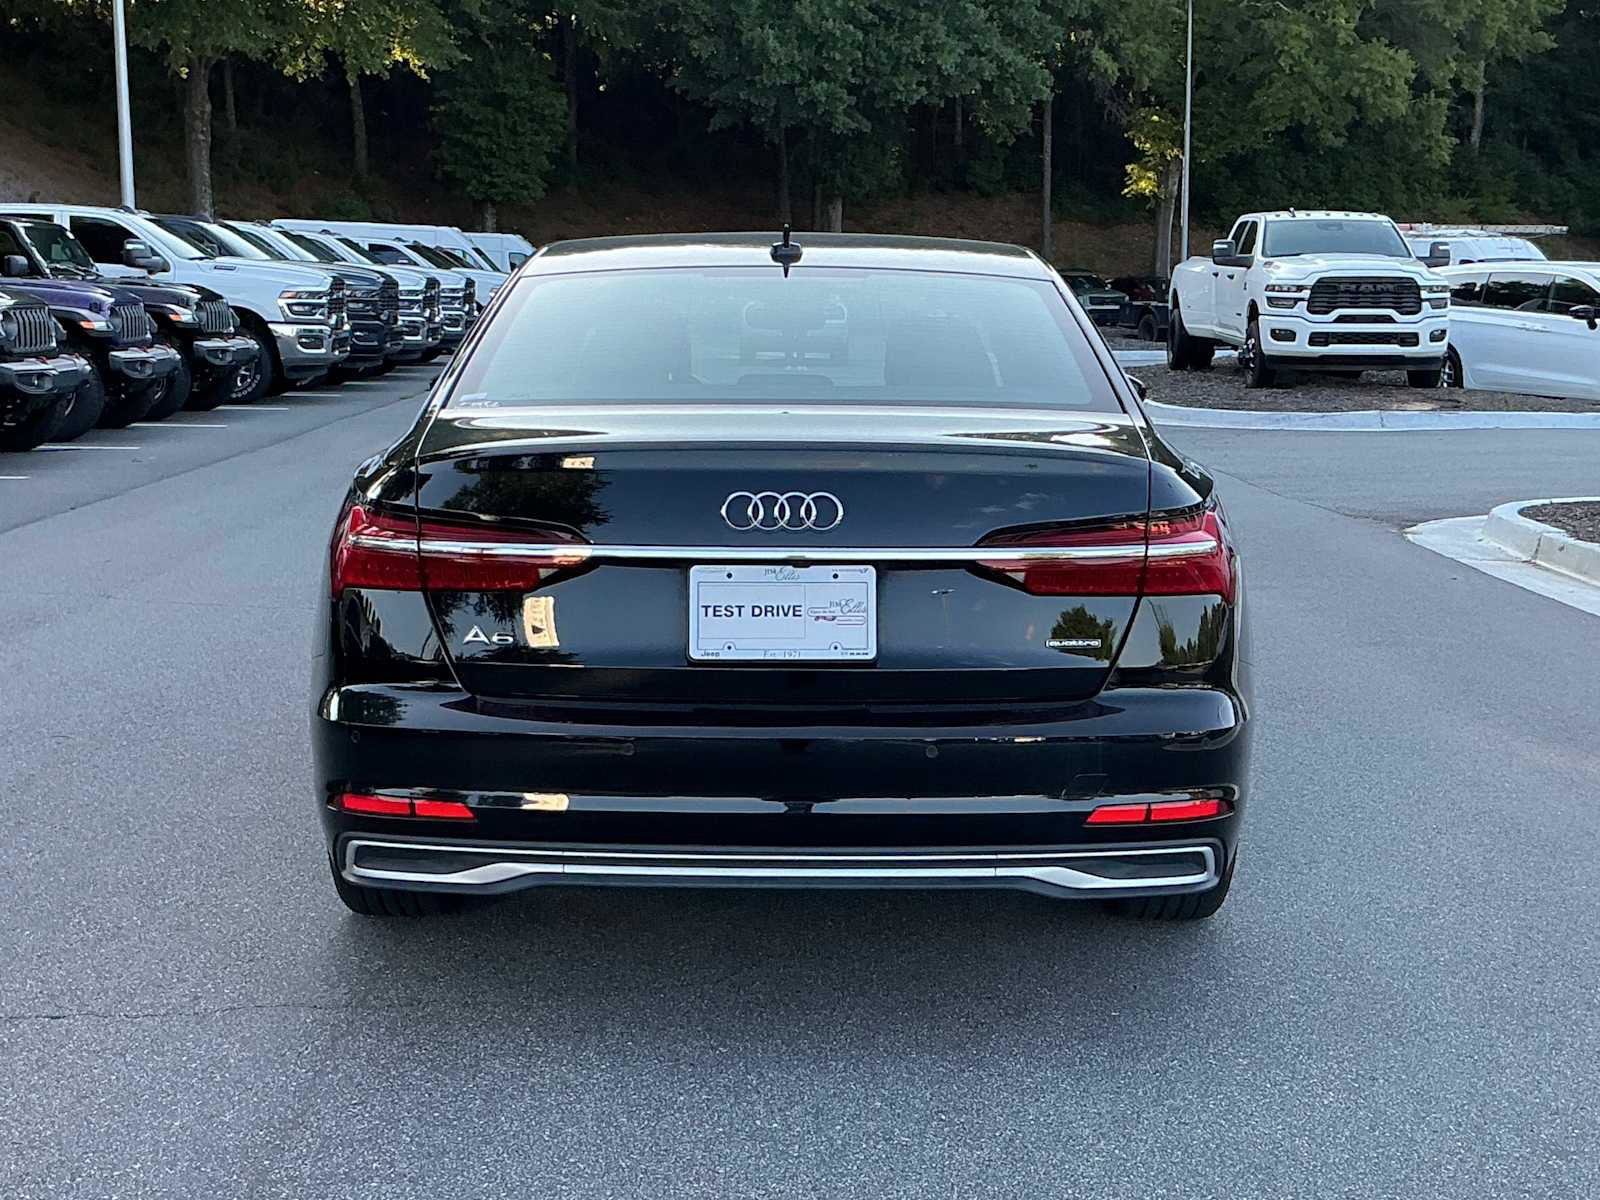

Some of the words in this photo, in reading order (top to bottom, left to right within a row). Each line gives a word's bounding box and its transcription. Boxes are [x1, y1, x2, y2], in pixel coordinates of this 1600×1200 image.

[701, 604, 745, 618] TEST
[751, 604, 803, 618] DRIVE
[463, 624, 514, 645] A6
[1048, 640, 1099, 648] quattro
